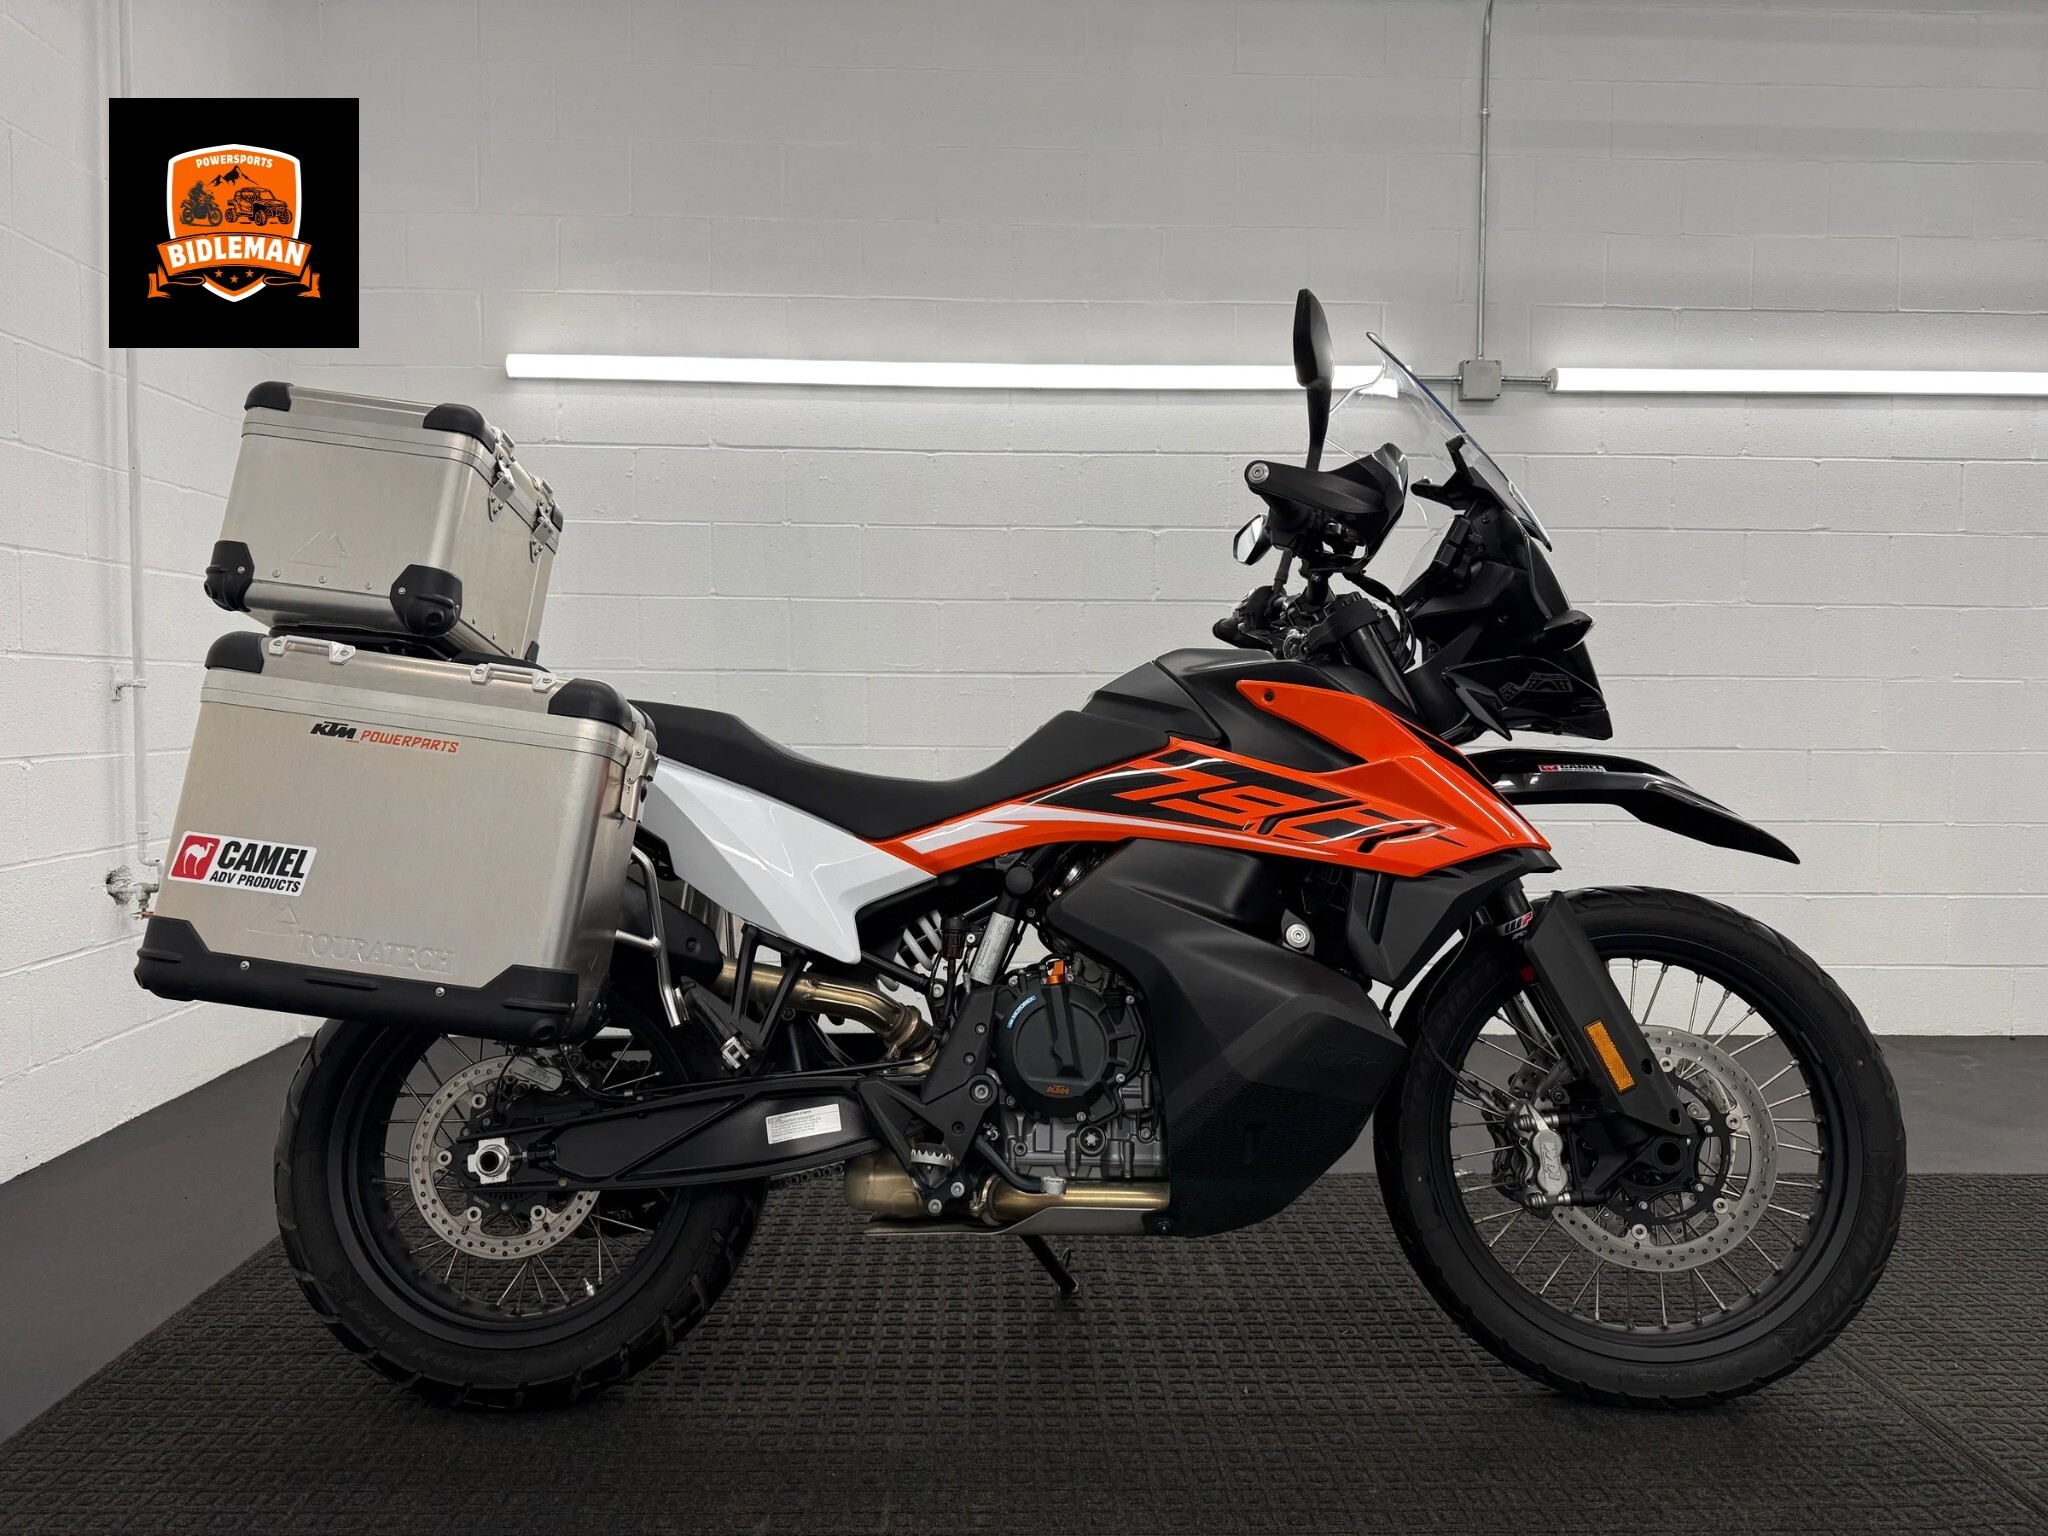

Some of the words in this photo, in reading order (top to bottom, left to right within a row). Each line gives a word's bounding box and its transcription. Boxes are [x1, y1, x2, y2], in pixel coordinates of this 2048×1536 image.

[310, 721, 357, 739] KTM
[360, 730, 459, 753] POWERPARTS
[217, 841, 308, 879] CAMEL
[209, 871, 236, 884] ADV
[237, 874, 301, 893] PRODUCTS
[297, 930, 454, 975] TOURATECH
[1046, 1085, 1070, 1095] KTM
